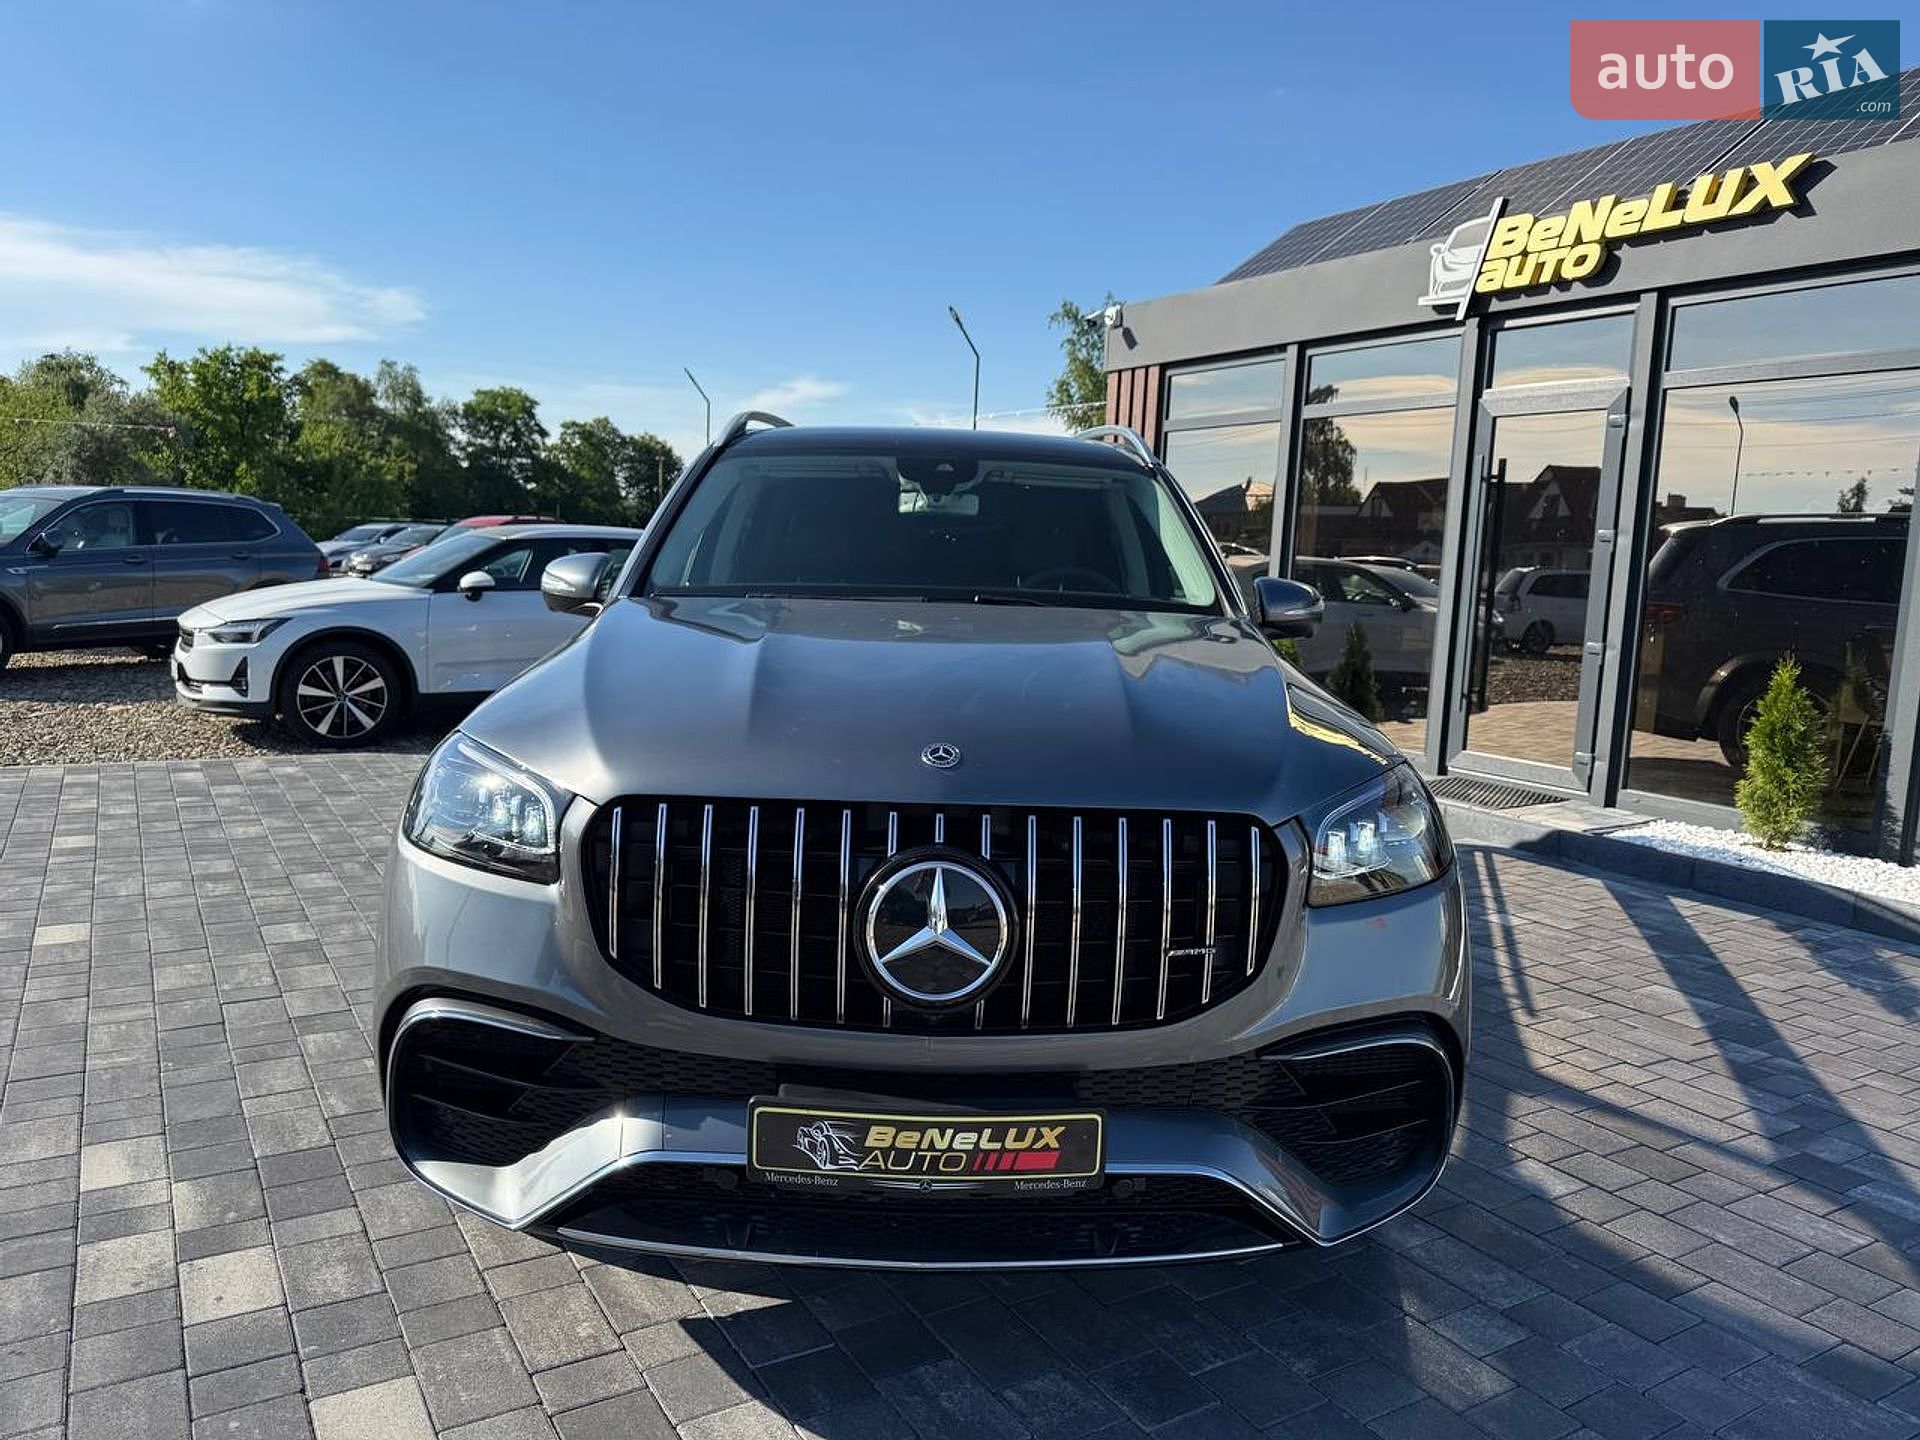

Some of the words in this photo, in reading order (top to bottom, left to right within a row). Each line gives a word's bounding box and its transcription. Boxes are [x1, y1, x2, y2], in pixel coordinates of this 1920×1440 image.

[1487, 152, 1815, 260] BeNeLUX
[864, 1125, 1066, 1150] BeNeLUX
[858, 1151, 968, 1171] AUTO
[764, 1172, 839, 1186] Mercedes-Benz
[1014, 1179, 1088, 1191] Mercedes-Benz
